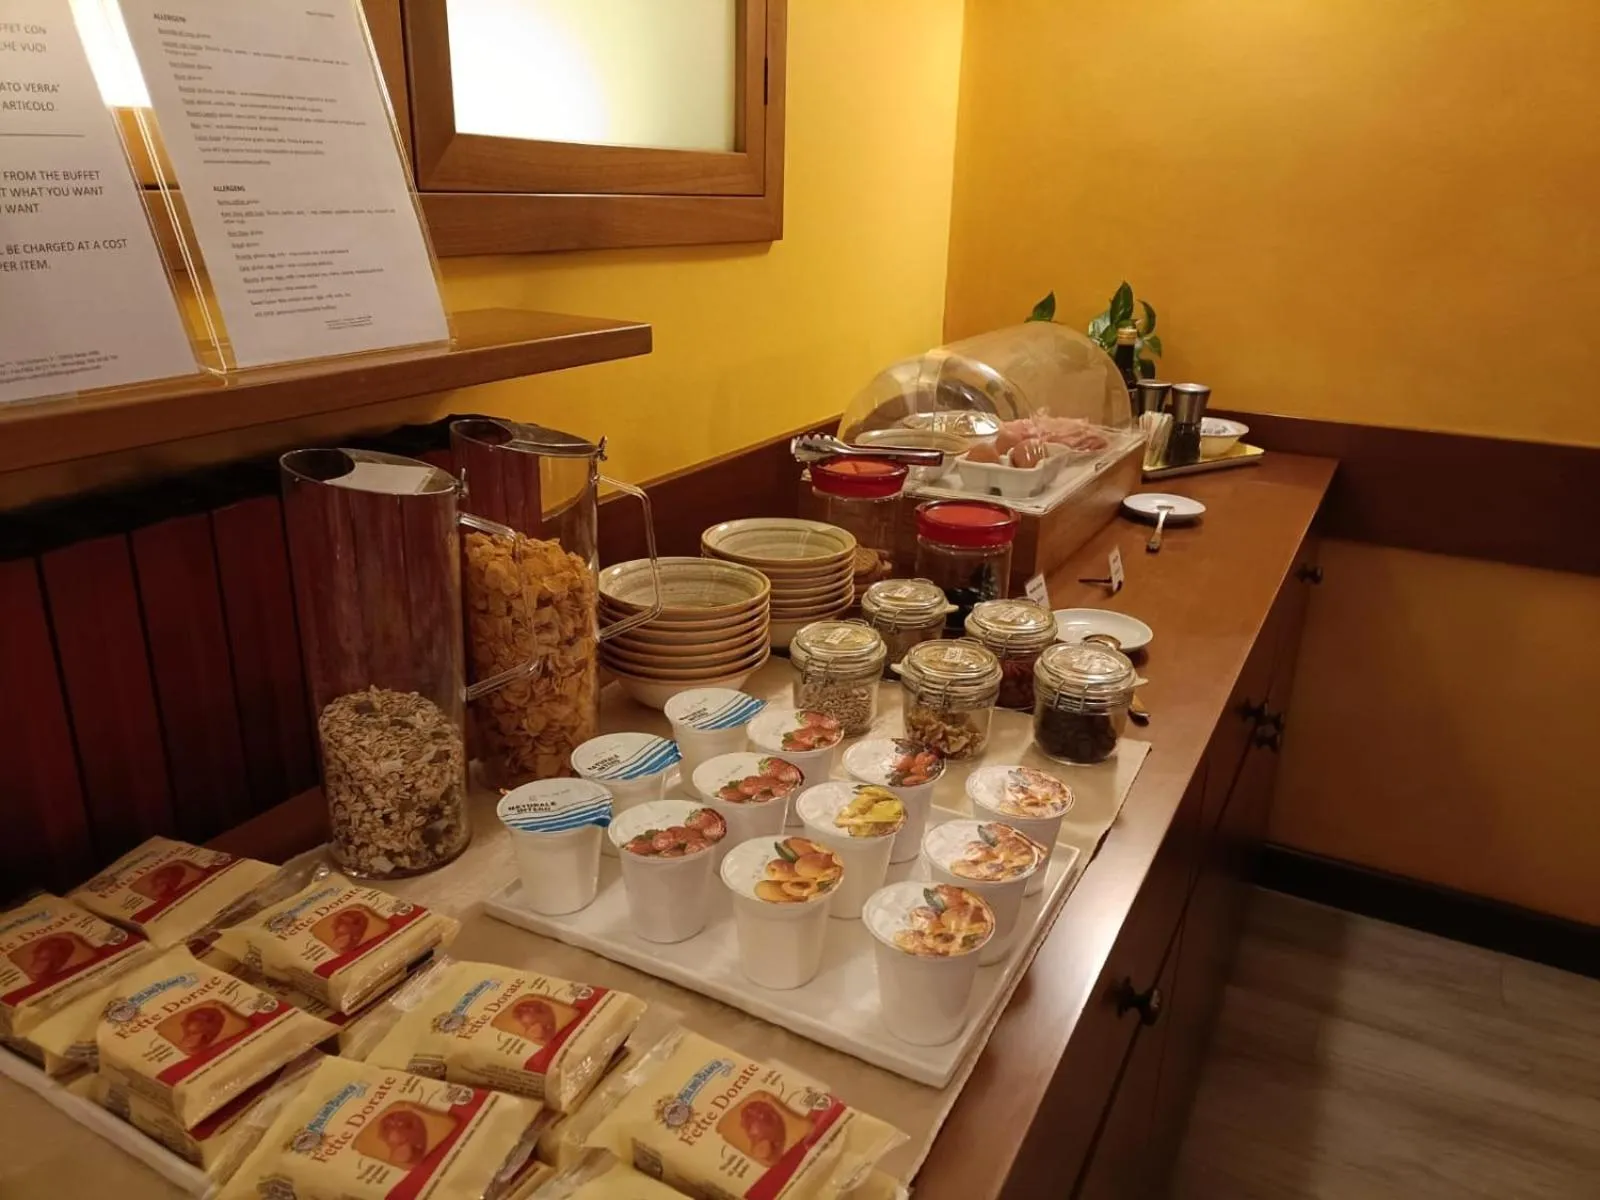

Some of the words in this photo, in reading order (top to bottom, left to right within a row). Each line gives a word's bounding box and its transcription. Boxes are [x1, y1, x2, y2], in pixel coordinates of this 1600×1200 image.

[20, 42, 47, 54] VUOI
[3, 170, 37, 181] FROM
[39, 170, 60, 181] THE
[63, 169, 101, 181] BUFFET
[9, 186, 46, 198] WHAT
[46, 186, 70, 197] YOU
[72, 185, 104, 196] WANT
[6, 243, 21, 255] BE
[22, 241, 75, 254] CHARGED
[77, 240, 91, 251] AT
[93, 240, 101, 250] A
[102, 238, 128, 250] COST
[20, 259, 51, 271] ITEM.
[484, 977, 526, 1013] Dorate
[115, 1013, 162, 1040] Fette
[161, 975, 223, 1014] Dorate
[678, 1113, 718, 1147] Fette
[710, 1063, 760, 1112] Dorate
[312, 1131, 353, 1164] Fette
[346, 1075, 397, 1129] Dorate
